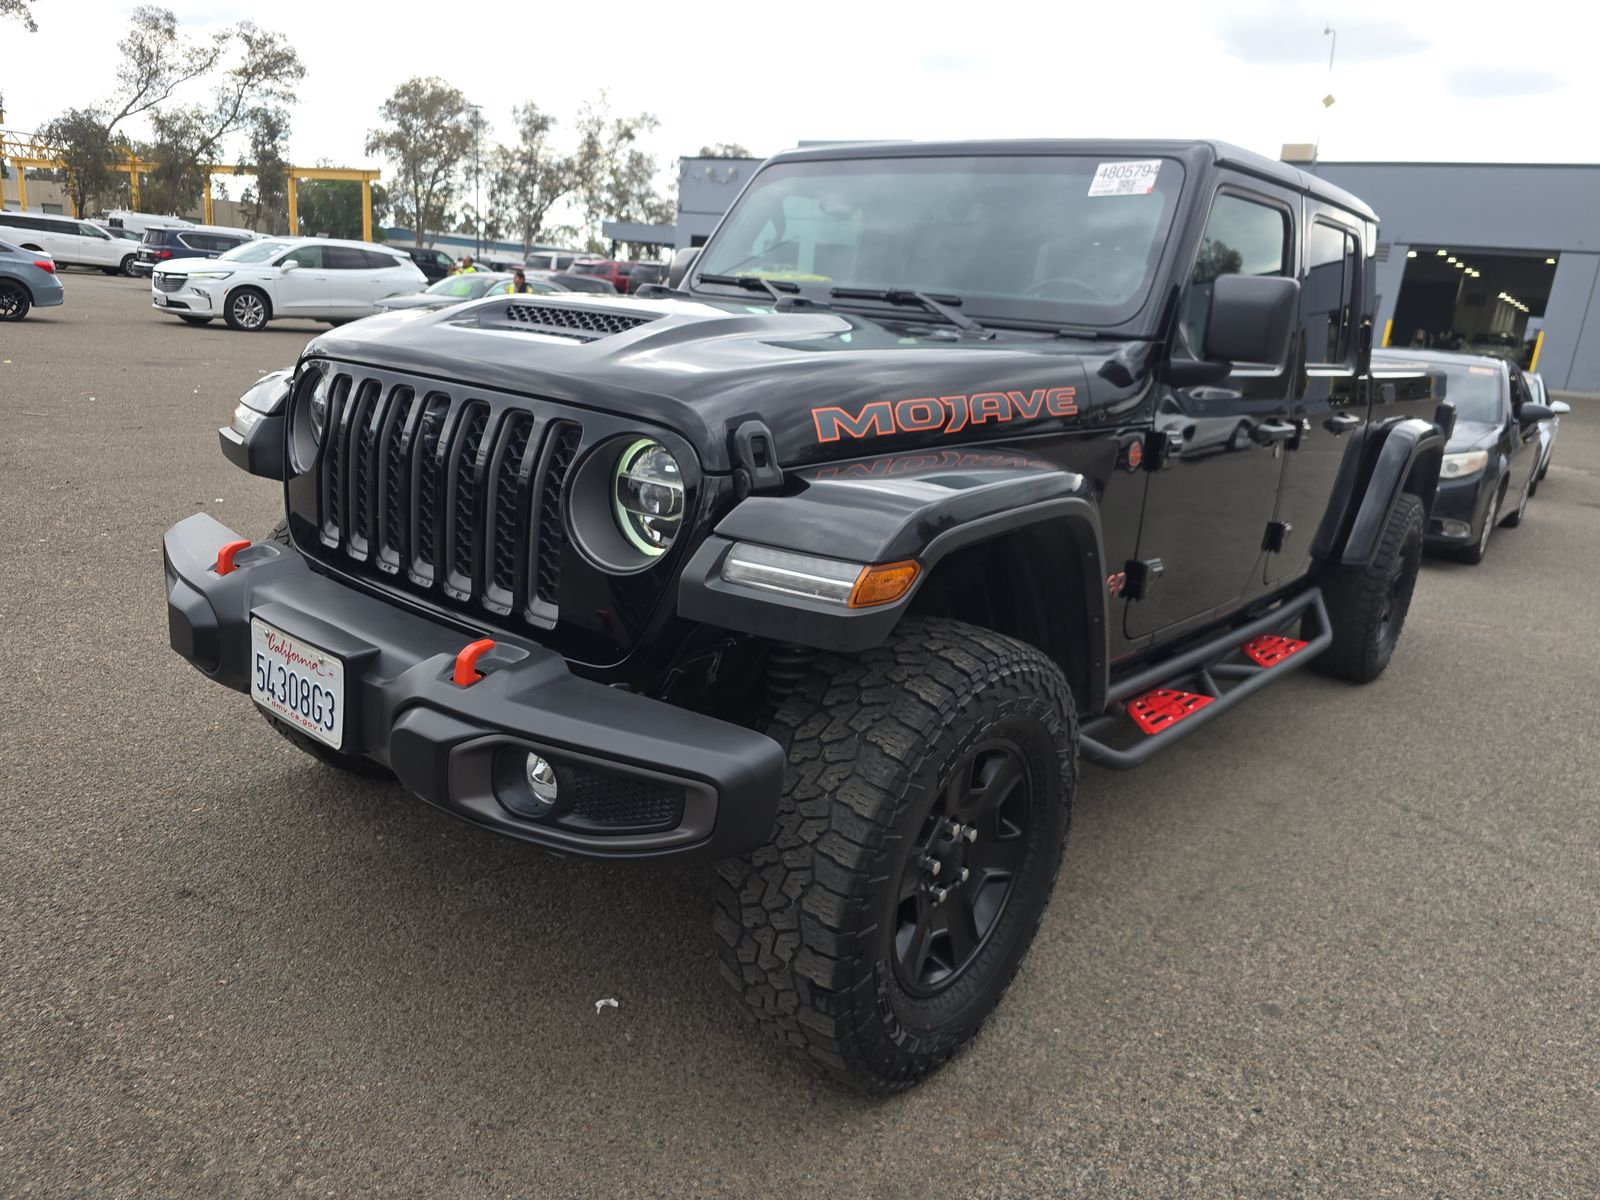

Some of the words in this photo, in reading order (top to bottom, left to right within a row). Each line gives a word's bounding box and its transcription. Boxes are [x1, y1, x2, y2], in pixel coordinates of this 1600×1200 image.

[1100, 164, 1160, 179] 4805794
[811, 387, 1079, 443] MOJAVE
[268, 632, 325, 677] California
[256, 651, 335, 731] 54308G3
[271, 699, 318, 730] dmv.ca.gov
